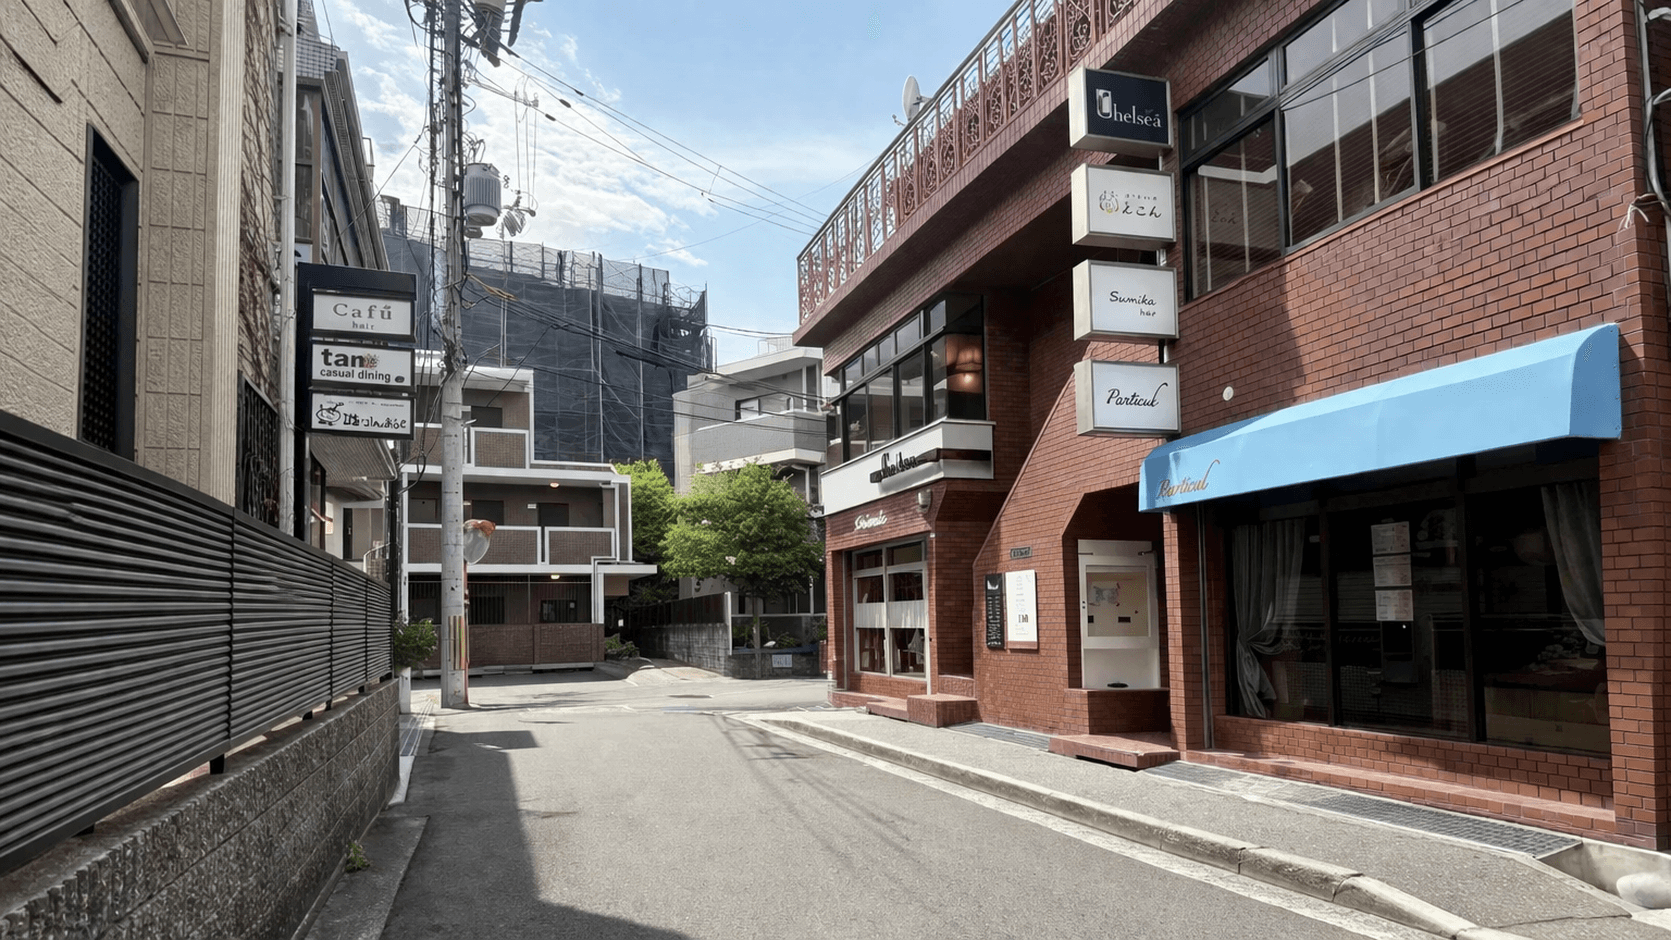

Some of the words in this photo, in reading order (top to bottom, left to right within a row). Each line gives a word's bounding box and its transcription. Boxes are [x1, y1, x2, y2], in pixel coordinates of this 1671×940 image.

[1109, 290, 1157, 307] Sumika
[320, 368, 355, 379] casual
[357, 370, 392, 384] dining
